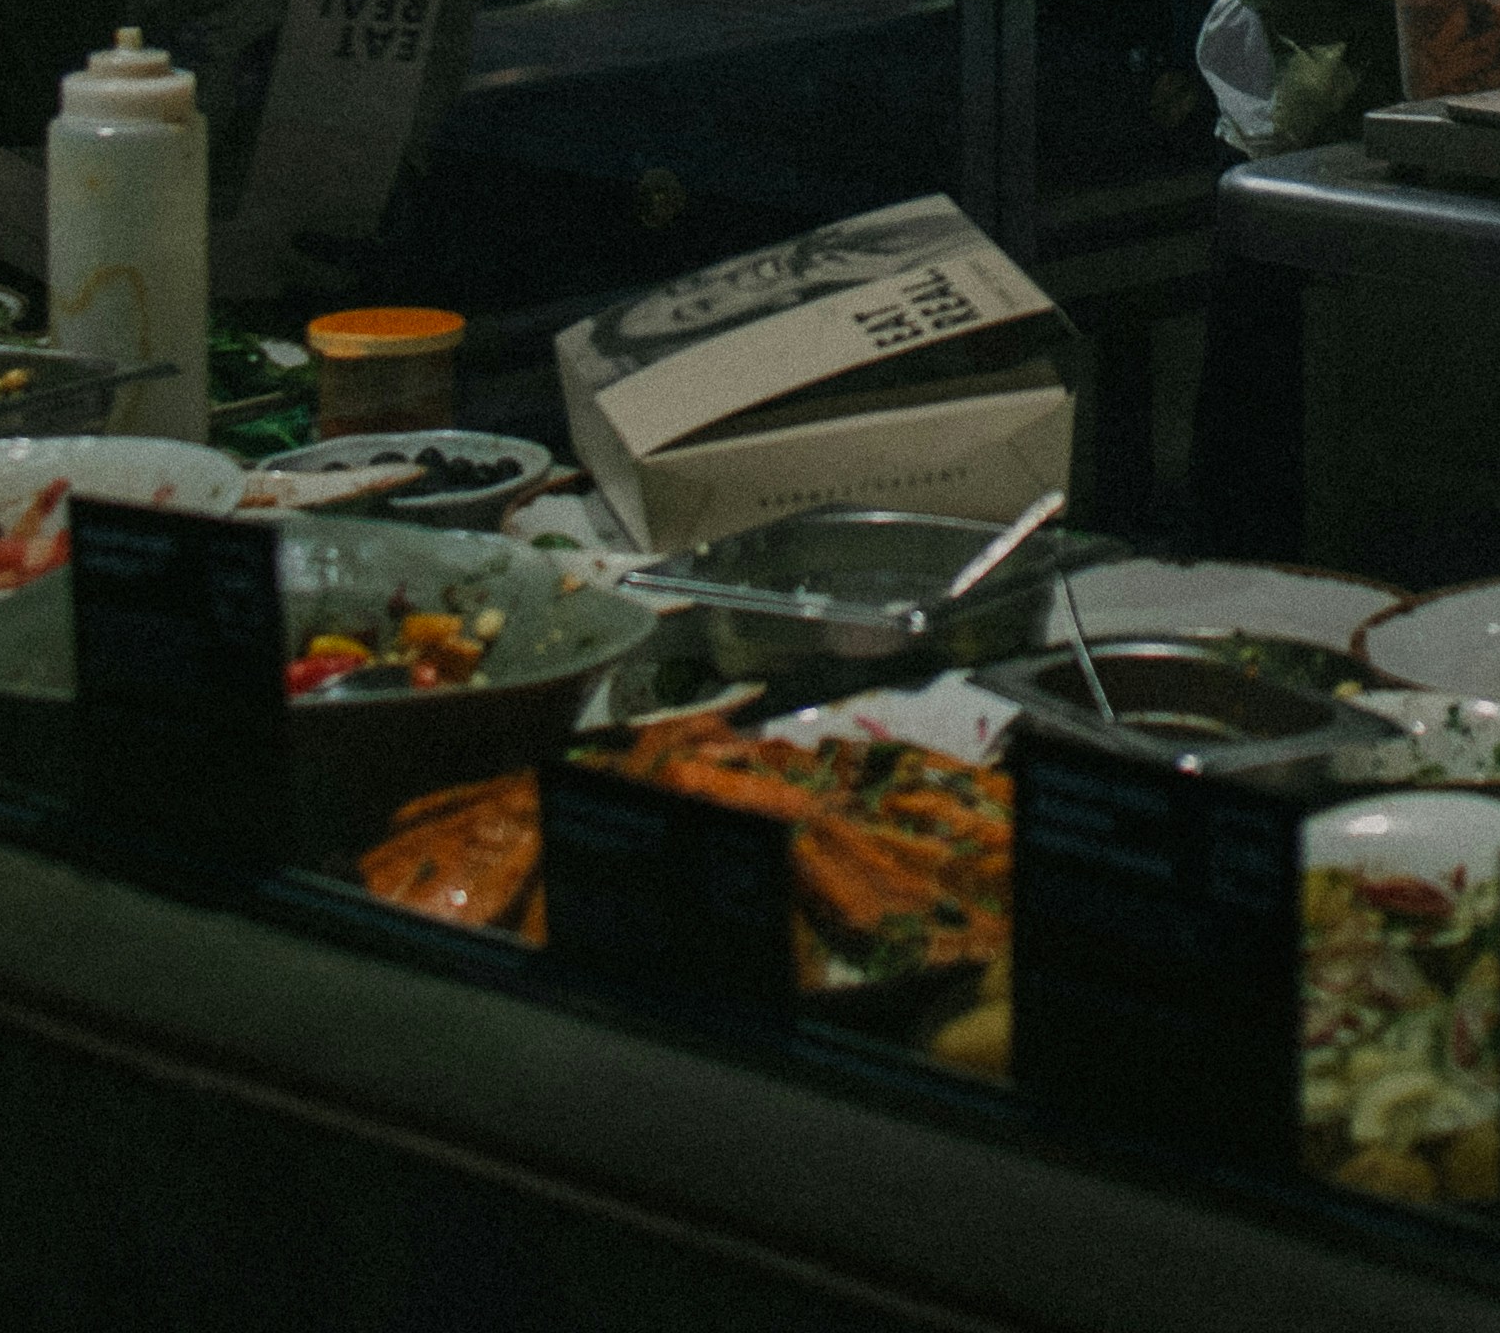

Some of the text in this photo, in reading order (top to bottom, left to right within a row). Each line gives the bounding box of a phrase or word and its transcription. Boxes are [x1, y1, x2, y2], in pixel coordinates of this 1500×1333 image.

[332, 24, 421, 64] EAT
[899, 266, 981, 332] REAL.
[852, 303, 924, 350] EAT
